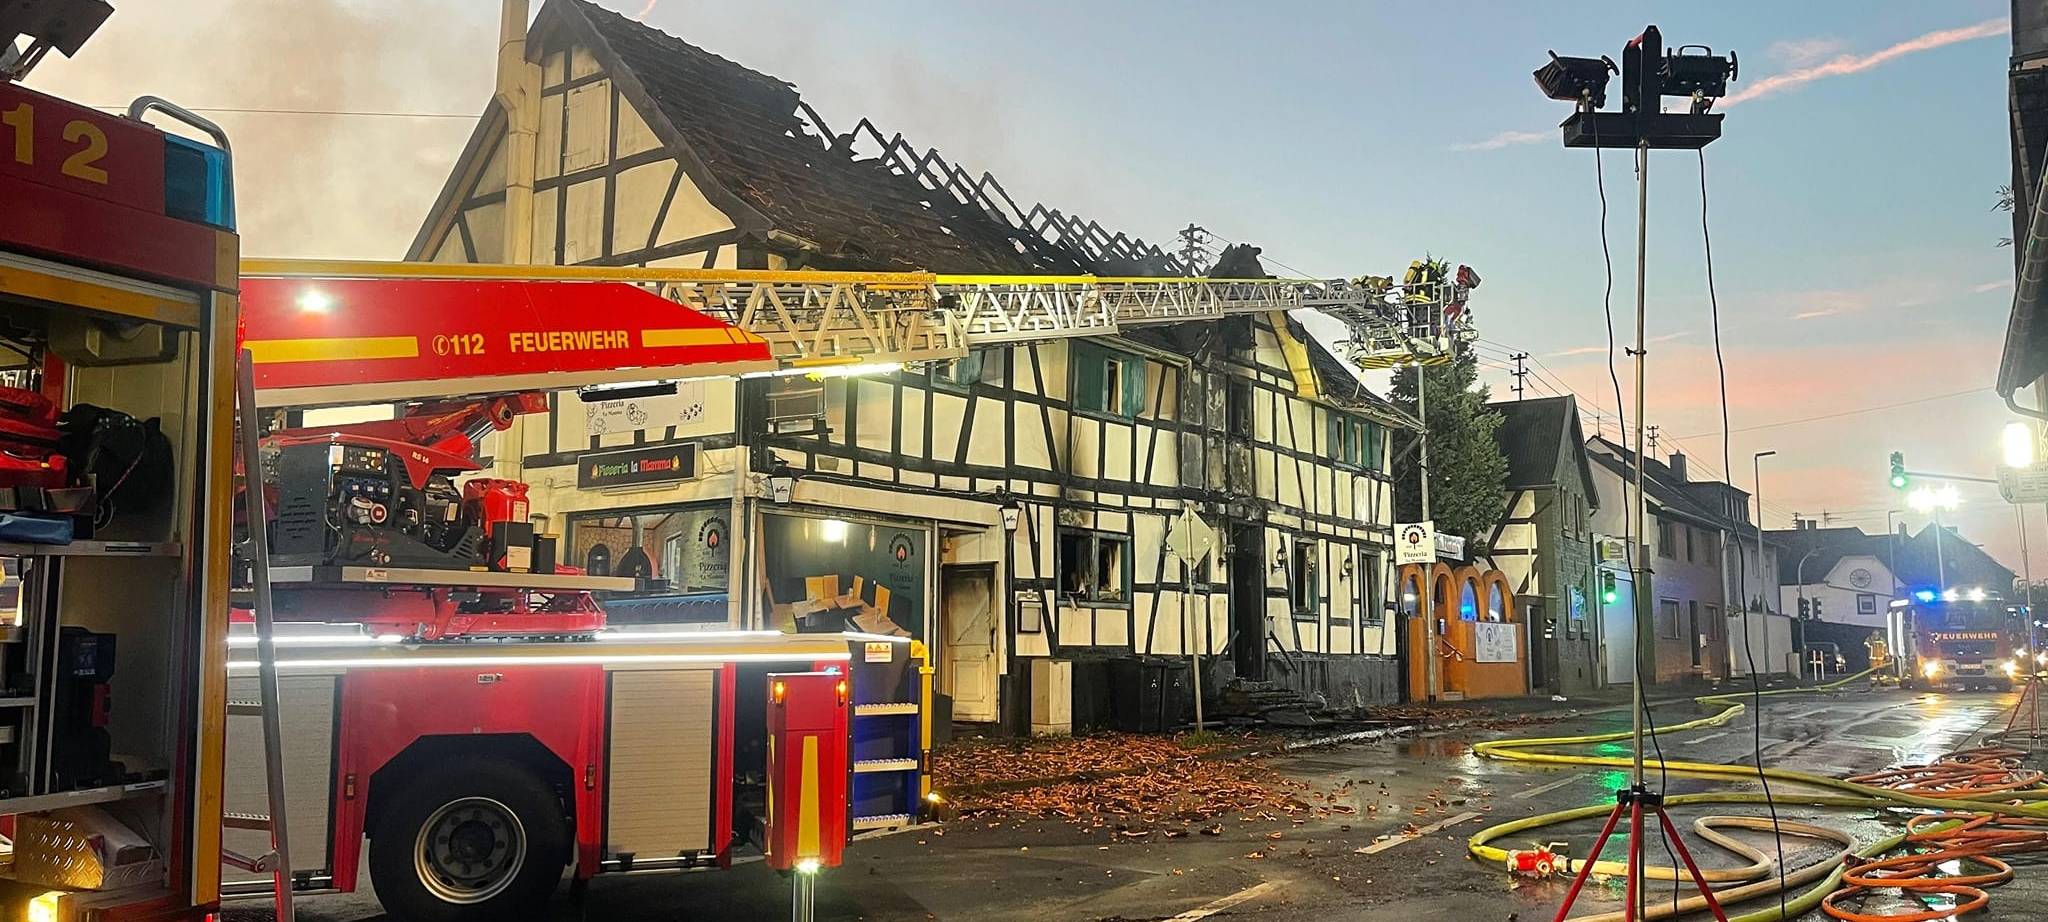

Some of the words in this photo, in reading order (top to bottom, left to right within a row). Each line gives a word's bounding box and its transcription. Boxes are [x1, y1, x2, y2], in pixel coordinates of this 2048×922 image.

[450, 333, 485, 354] 112
[509, 330, 629, 353] FEUERWEHR
[599, 462, 628, 477] Pizzeria
[630, 460, 638, 473] la
